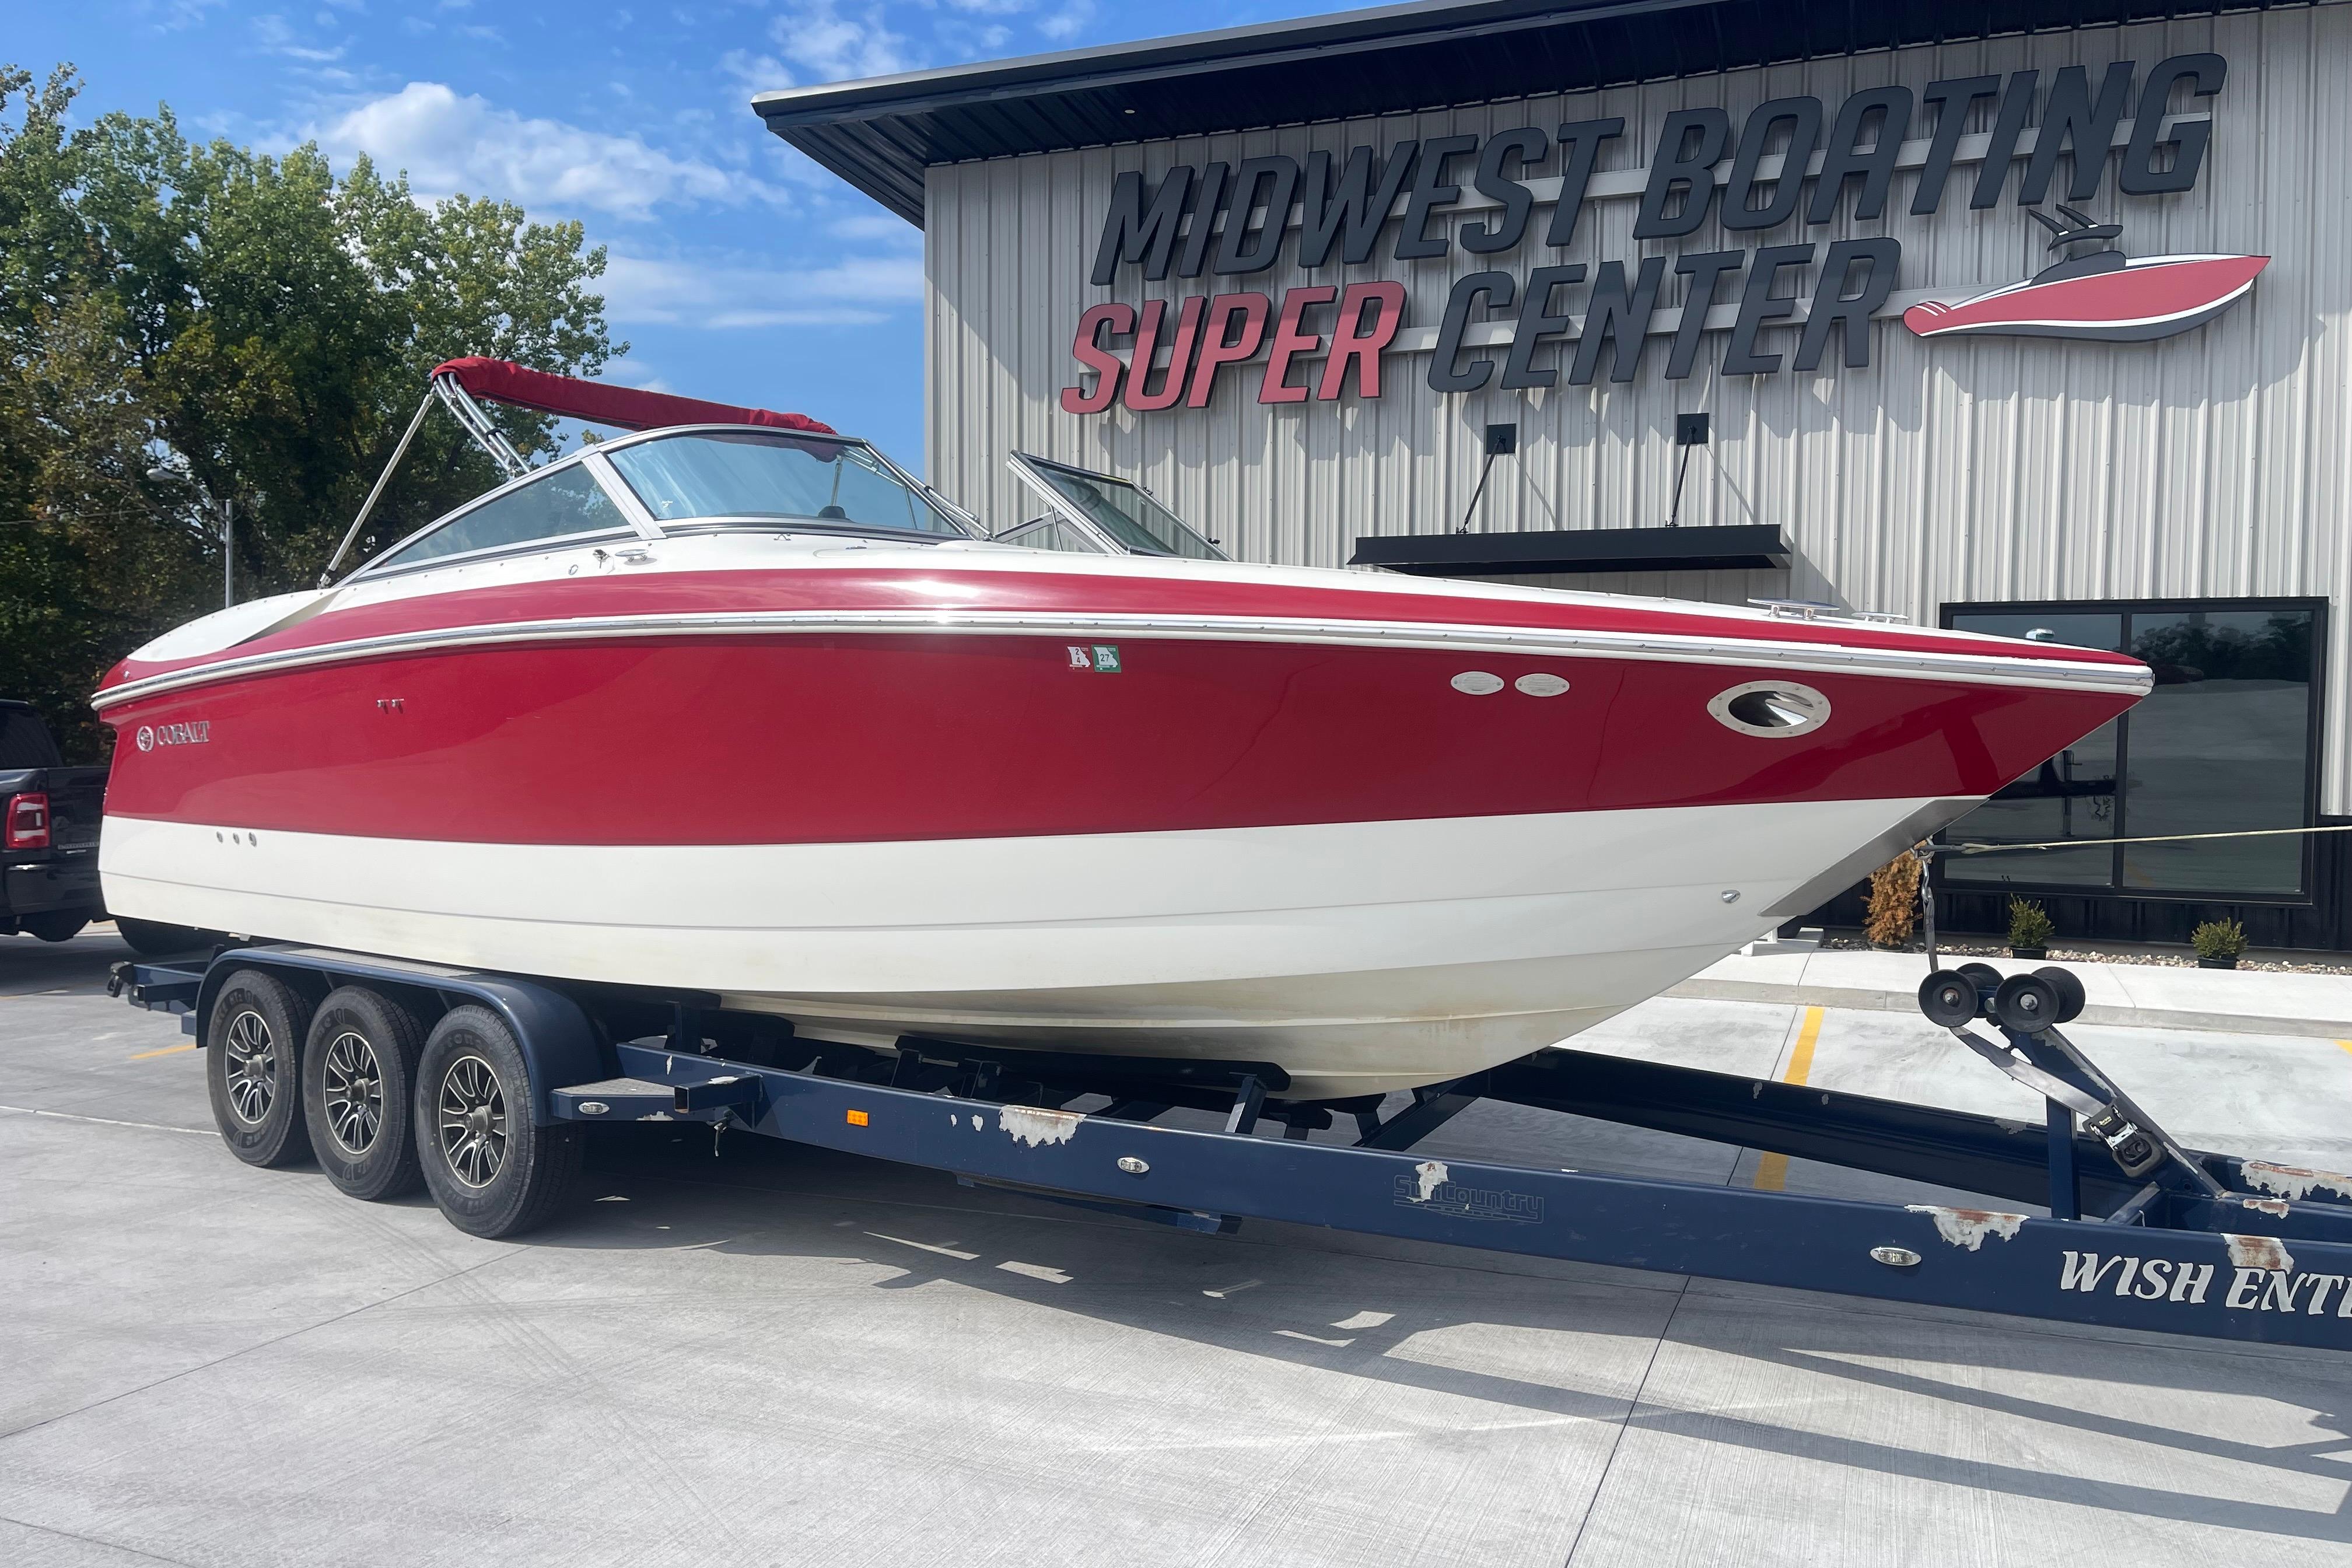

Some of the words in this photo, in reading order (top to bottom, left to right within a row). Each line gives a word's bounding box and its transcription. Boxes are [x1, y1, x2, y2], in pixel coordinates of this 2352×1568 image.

[1091, 116, 1625, 286] MIDWEST
[1633, 52, 2228, 240] BOATING
[1060, 280, 1408, 414] SUPER
[1427, 237, 1901, 393] CENTER
[157, 721, 209, 746] COBALT
[2060, 1250, 2215, 1304] WISH
